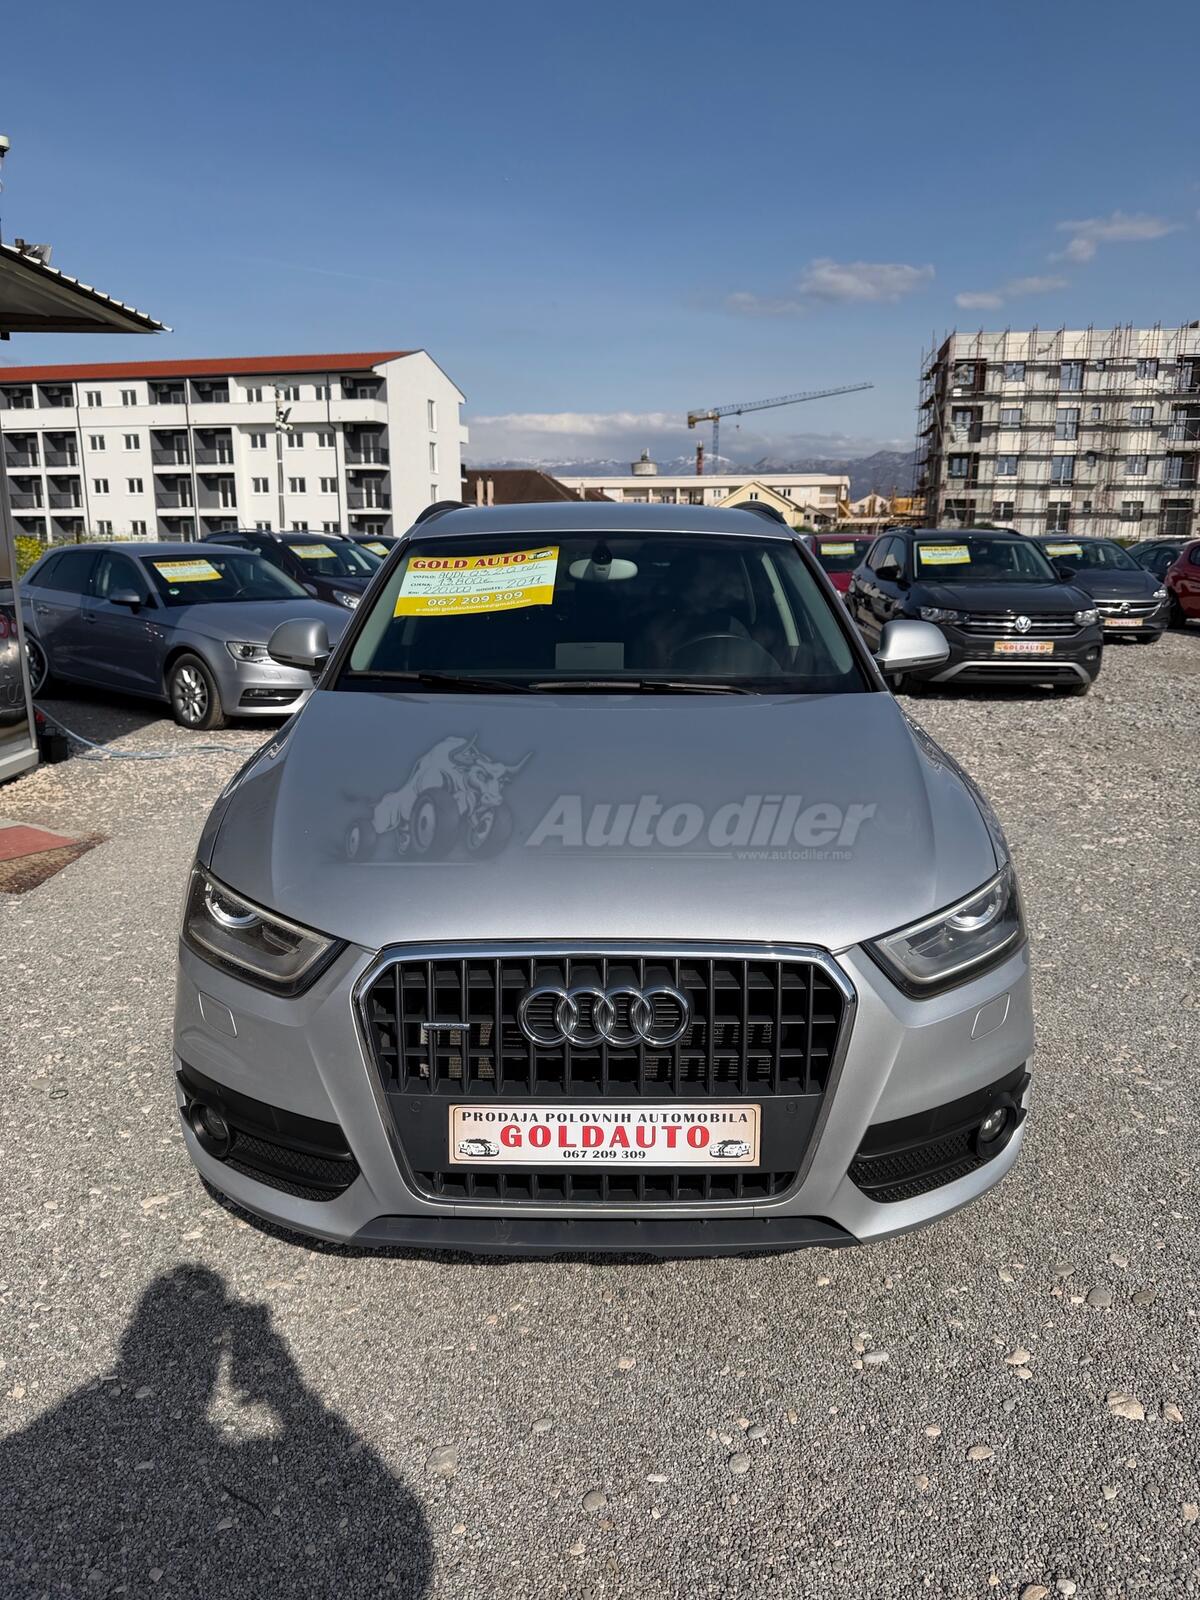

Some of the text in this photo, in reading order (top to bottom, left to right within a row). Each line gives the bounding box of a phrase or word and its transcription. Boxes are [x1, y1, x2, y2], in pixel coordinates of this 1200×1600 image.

[413, 553, 527, 569] GOLD AUTO
[427, 591, 523, 606] 067 209 309
[462, 1111, 749, 1123] PRODAJA POLOVNIH AUTOMOBILA
[499, 1124, 711, 1149] GOLDAUTO
[562, 1150, 646, 1160] 067 209 309
